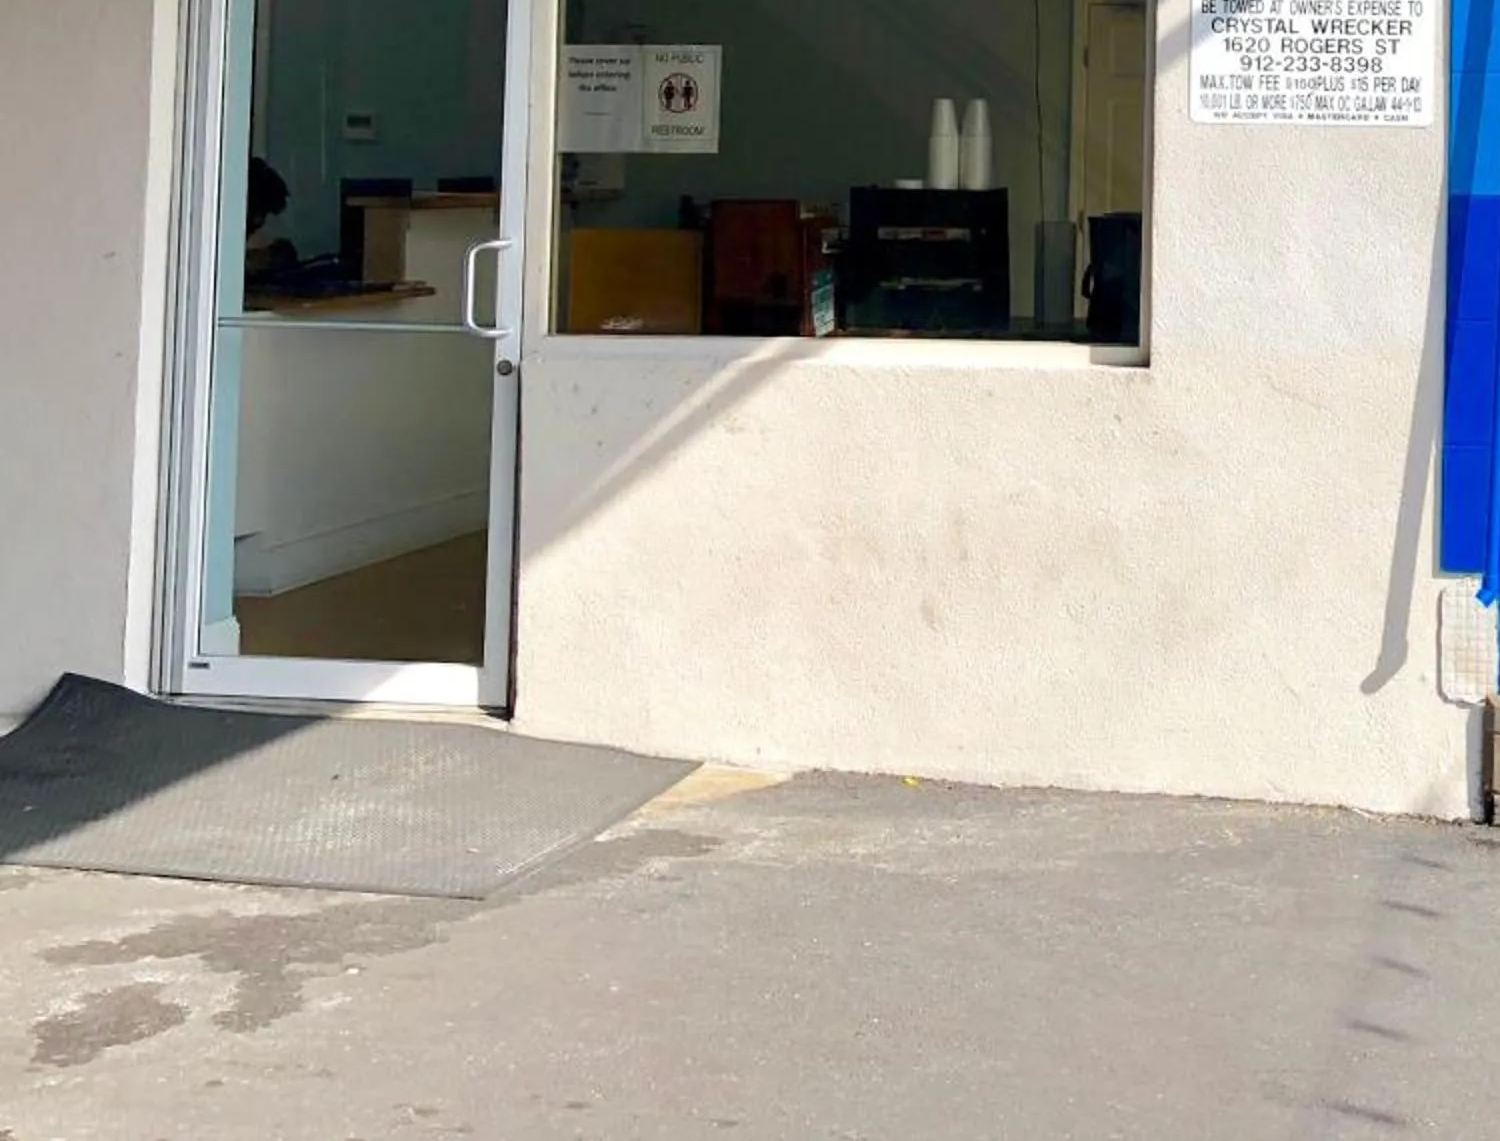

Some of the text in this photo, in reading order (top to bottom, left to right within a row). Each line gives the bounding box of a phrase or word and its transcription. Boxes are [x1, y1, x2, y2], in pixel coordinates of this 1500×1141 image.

[1270, 0, 1284, 15] AT
[1347, 0, 1402, 17] EXPENSE
[1408, 0, 1424, 18] TO
[1211, 16, 1413, 36] CRYSTAL WRECKER
[1224, 37, 1401, 55] 1620 ROGERS ST
[1240, 55, 1384, 73] 912-233-8398
[1259, 74, 1280, 90] FEE
[1374, 76, 1396, 93] PER
[1401, 76, 1421, 93] DAY
